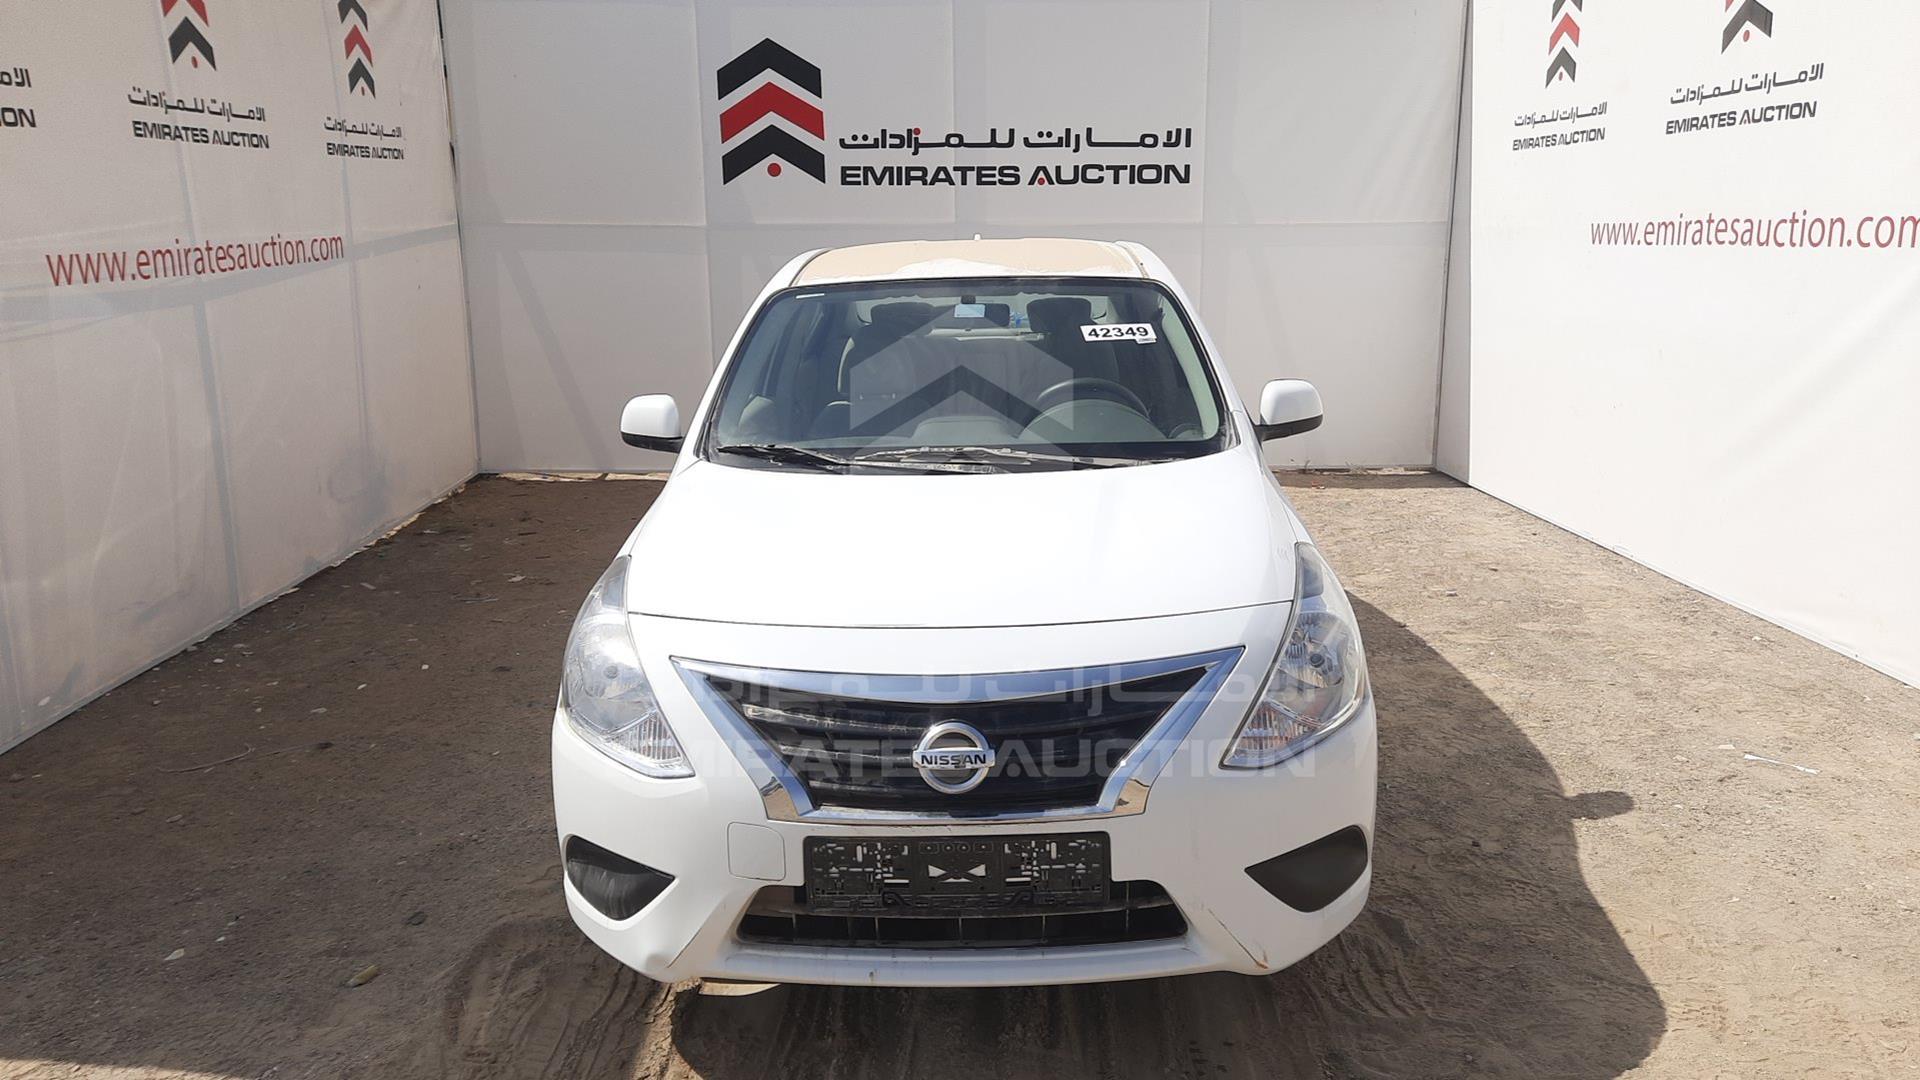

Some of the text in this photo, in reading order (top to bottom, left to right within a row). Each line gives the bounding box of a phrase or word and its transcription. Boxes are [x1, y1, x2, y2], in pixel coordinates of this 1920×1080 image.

[1670, 62, 1825, 105] الامارات للمزادات
[127, 86, 267, 122] الامارات للمزادات
[1665, 101, 1817, 135] EMIRATES AUCTION
[132, 120, 270, 149] EMIRATES AUCTION
[839, 127, 1192, 156] الامارات للمزادات
[1512, 127, 1605, 151] EMIRATES AUCTION
[326, 142, 404, 160] EMIRATES AUCTION
[840, 163, 1191, 186] EMIRATES AUCTION
[1591, 209, 1920, 248] www.emiratesauction.com
[45, 233, 345, 287] www.emiratesauction.com
[1088, 326, 1149, 338] 42349
[921, 754, 987, 766] NISSAN
